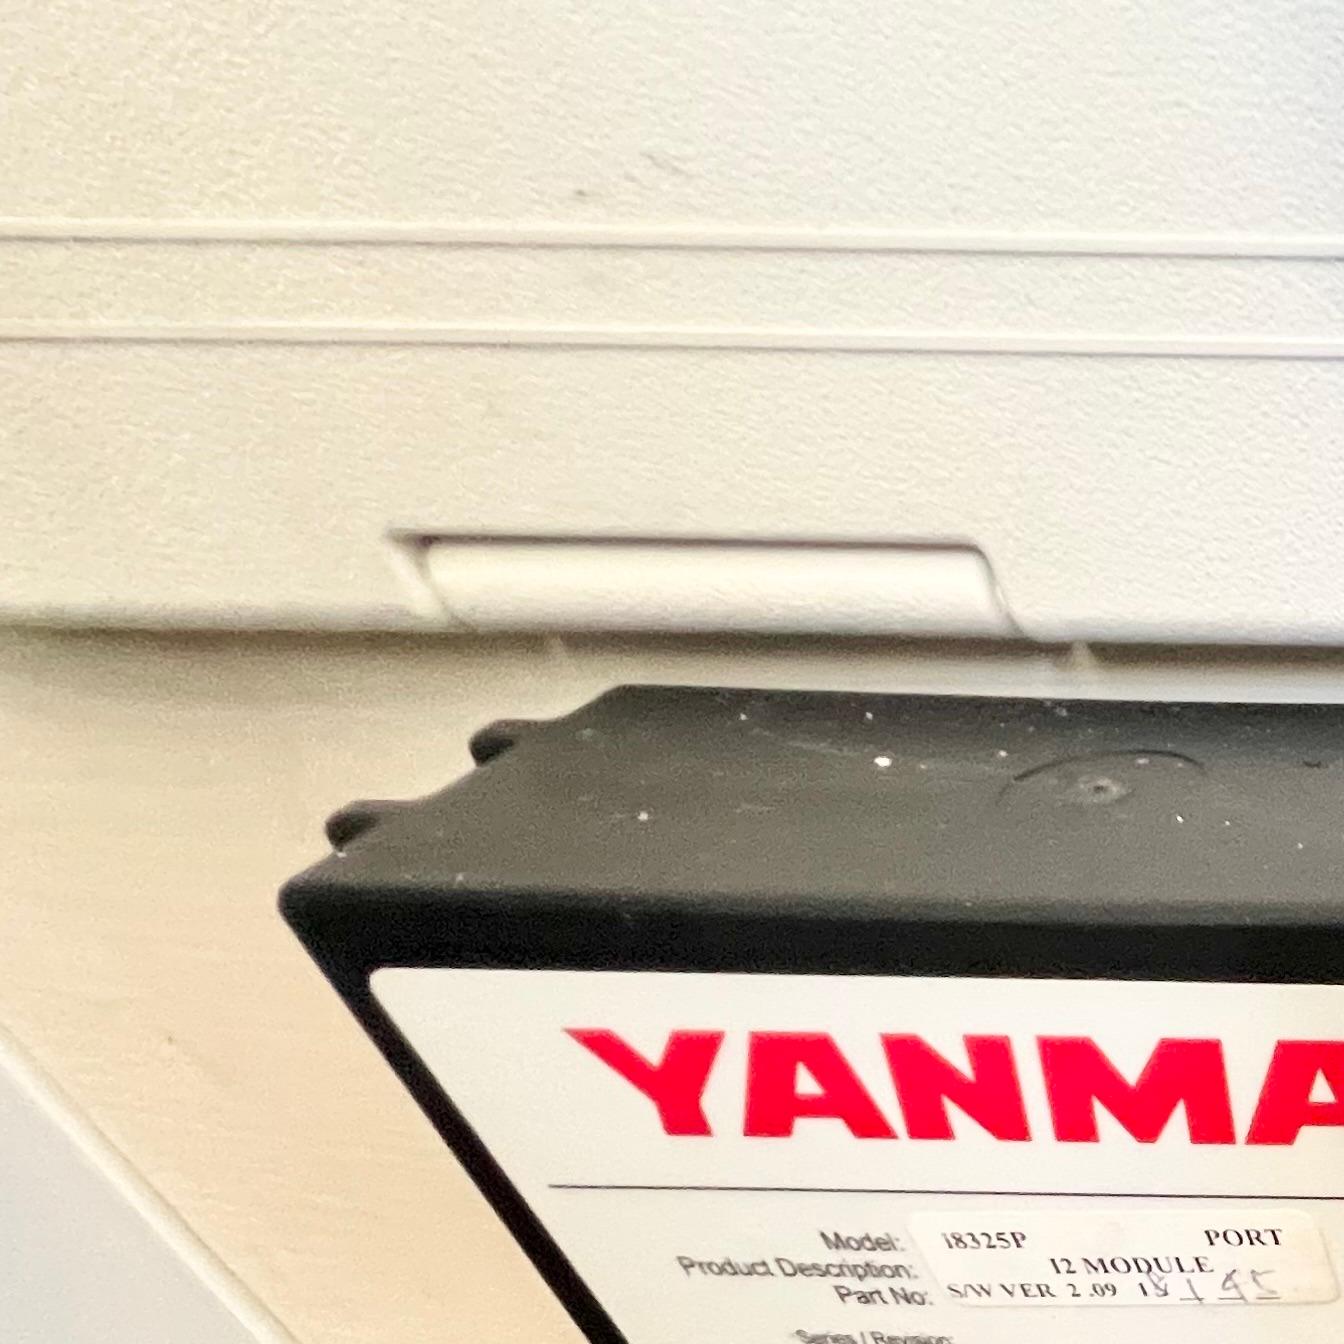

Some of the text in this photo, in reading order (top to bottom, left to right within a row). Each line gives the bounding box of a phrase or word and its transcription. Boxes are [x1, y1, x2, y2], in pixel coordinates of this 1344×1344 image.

[819, 1231, 904, 1251] Model:
[1204, 1228, 1283, 1246] PORT
[676, 1255, 918, 1281] Product Description:
[1083, 1257, 1213, 1274] MODULE
[834, 1285, 933, 1306] Part No:
[947, 1282, 993, 1299] S/W
[1001, 1282, 1056, 1299] VER
